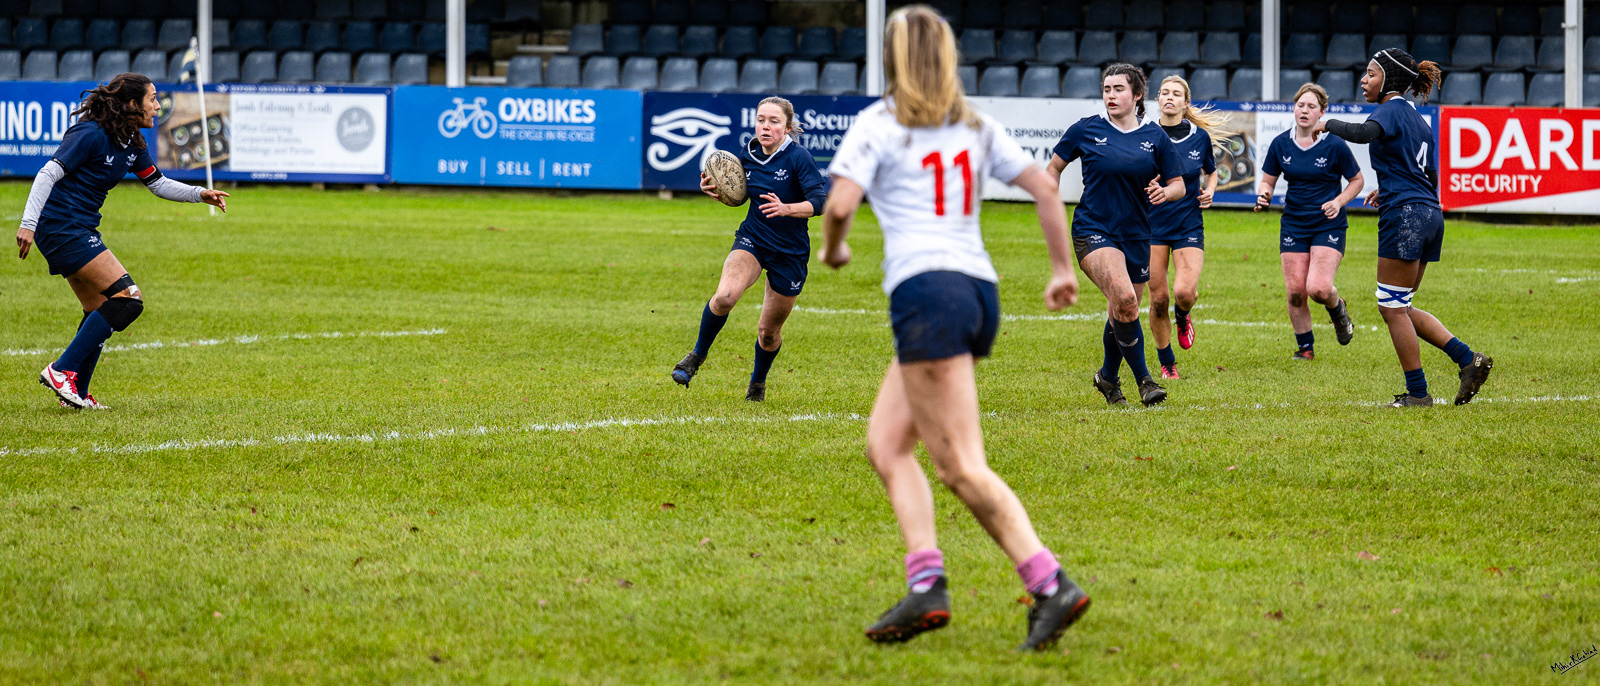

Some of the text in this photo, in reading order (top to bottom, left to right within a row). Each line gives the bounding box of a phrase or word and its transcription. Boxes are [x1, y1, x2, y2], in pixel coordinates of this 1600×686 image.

[498, 97, 596, 124] OXBIKES
[1256, 103, 1287, 112] OXFORD
[500, 130, 516, 140] THE
[517, 130, 543, 141] CYCLE
[546, 131, 556, 141] IN
[1015, 128, 1064, 138] SPONSOR
[1416, 141, 1428, 173] 4
[438, 159, 592, 177] BUY SELL RENT
[921, 149, 974, 217] 11
[1450, 173, 1542, 193] SECURITY
